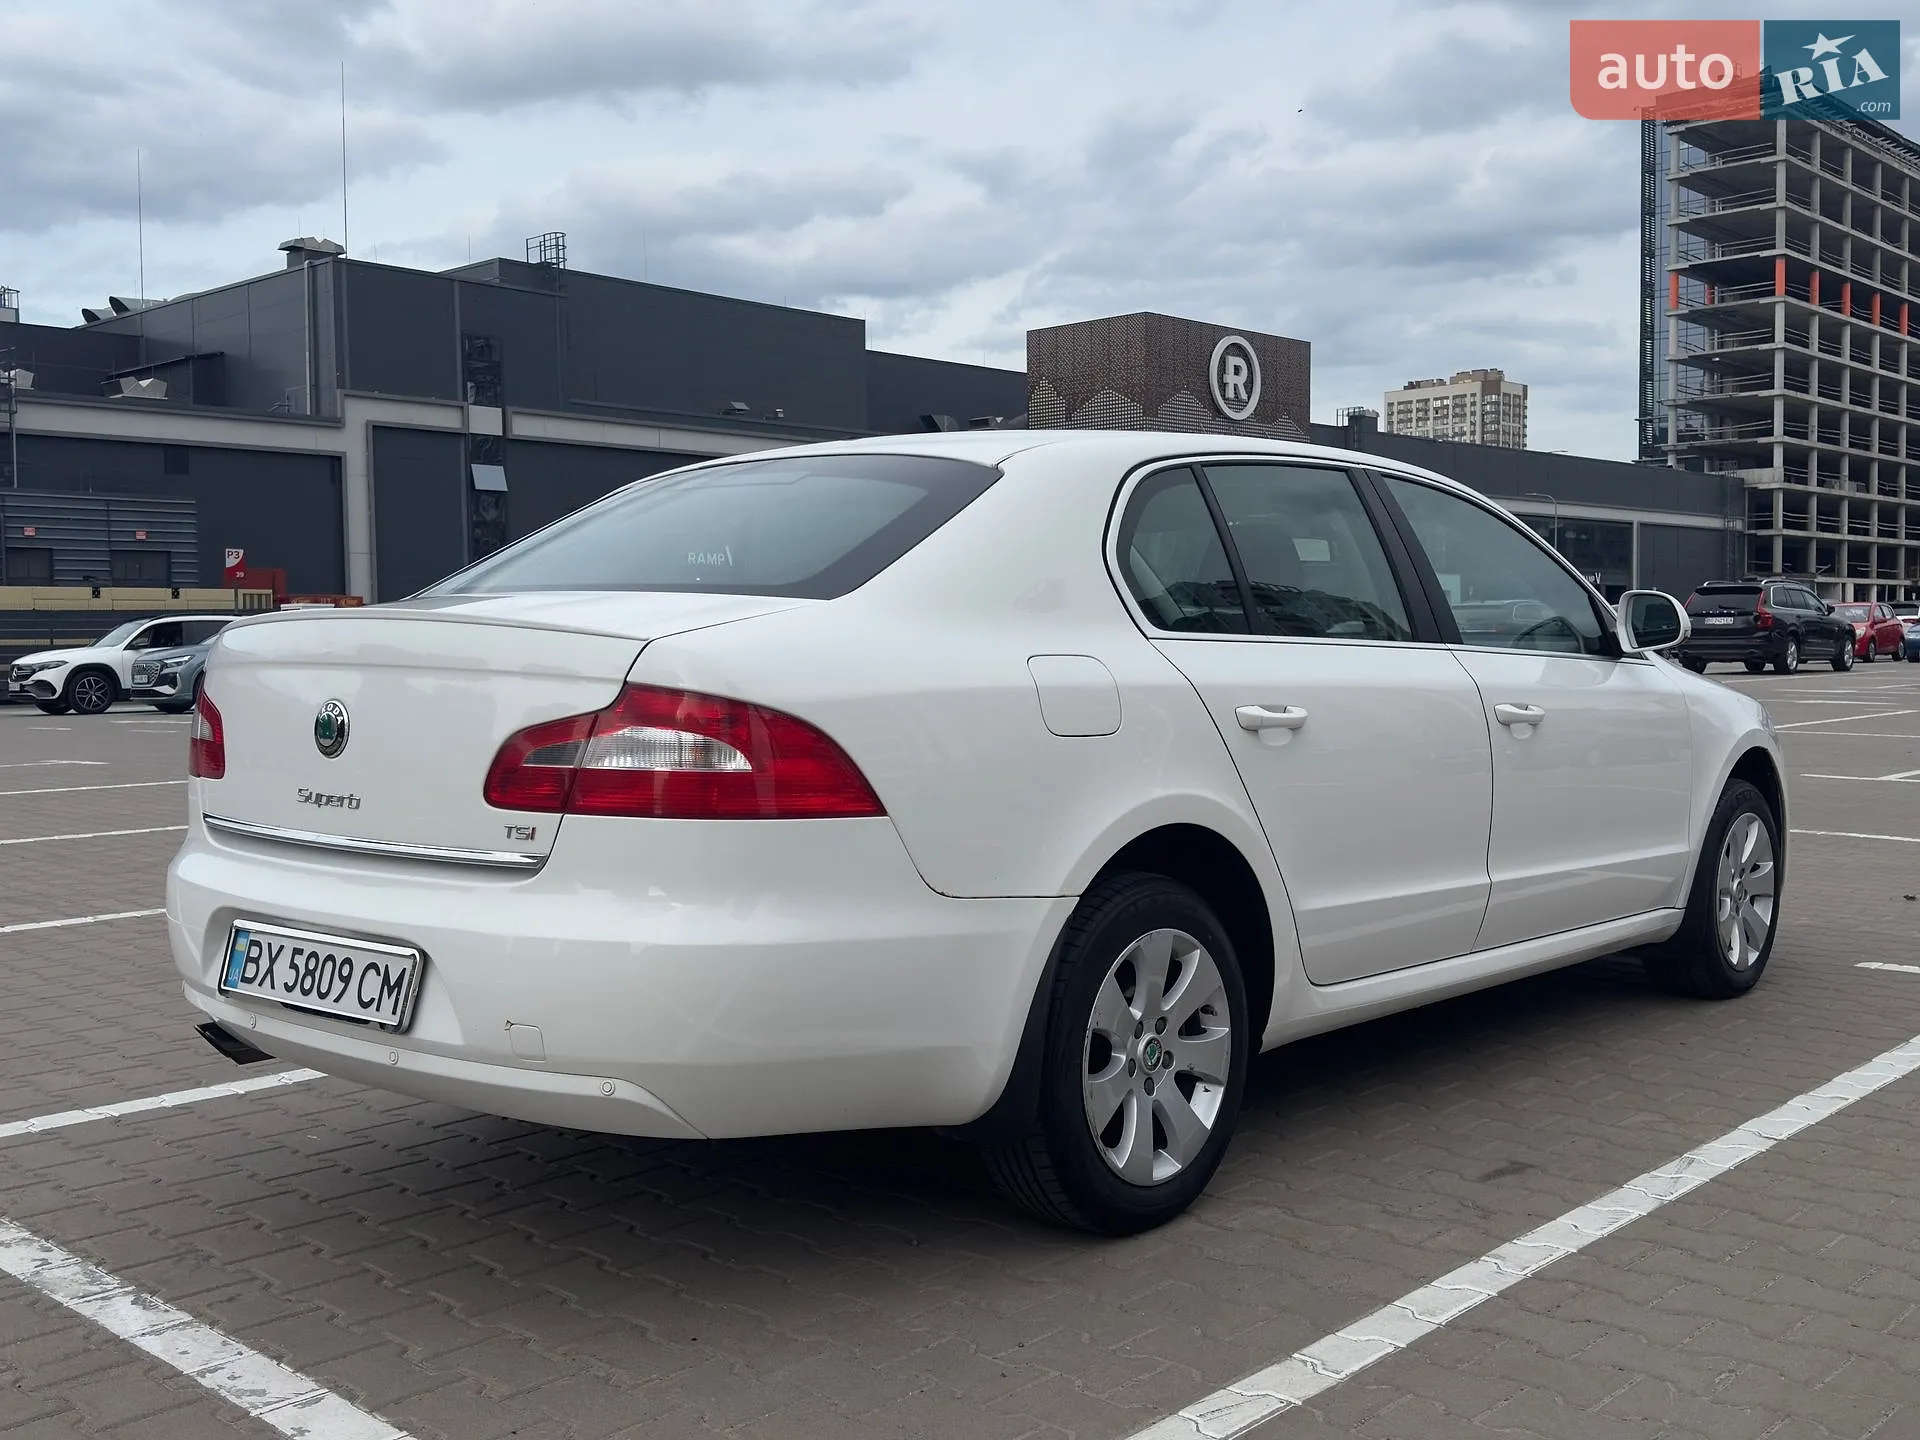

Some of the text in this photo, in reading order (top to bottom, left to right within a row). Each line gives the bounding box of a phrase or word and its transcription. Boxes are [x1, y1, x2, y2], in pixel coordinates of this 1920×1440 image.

[227, 550, 241, 560] P3
[296, 788, 361, 810] Superb
[503, 824, 537, 841] TSI
[240, 938, 407, 1016] BX 5809 CM
